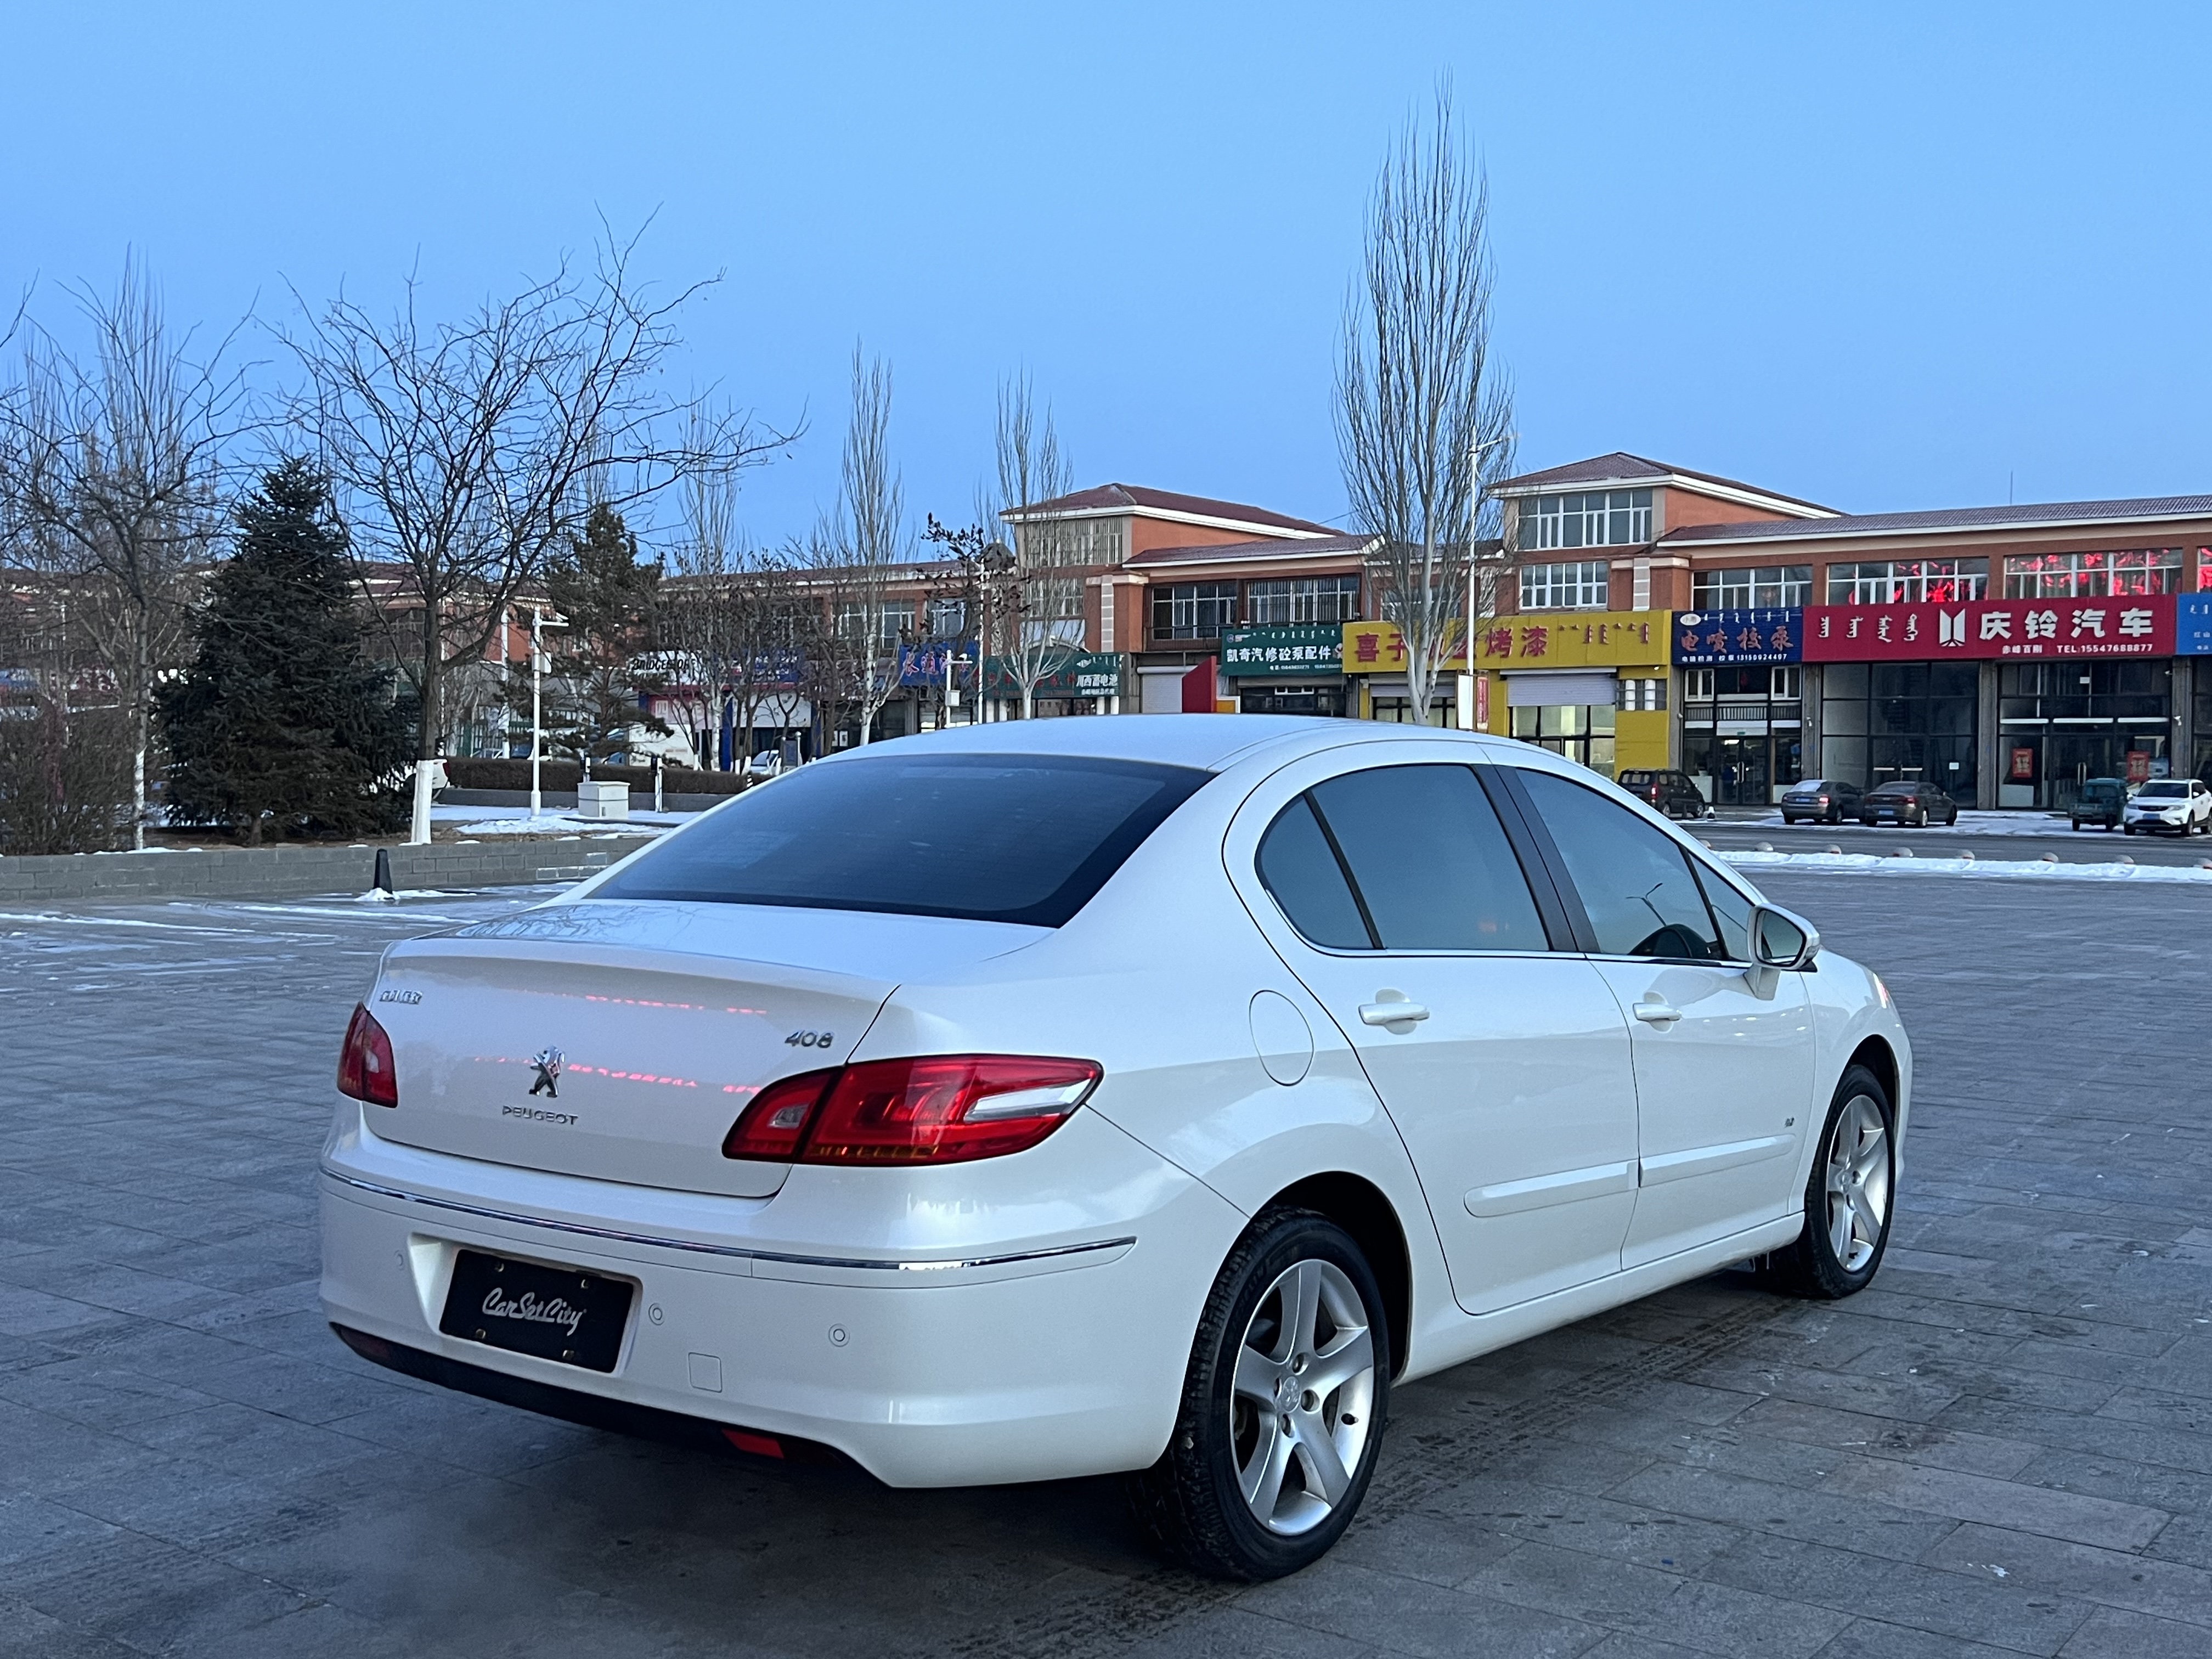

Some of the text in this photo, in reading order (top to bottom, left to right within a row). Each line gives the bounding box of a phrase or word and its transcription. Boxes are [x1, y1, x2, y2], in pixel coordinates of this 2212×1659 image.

[1979, 608, 2153, 640] 庆铃汽车
[1227, 645, 1331, 662] 凯奇汽修砼泵配件
[1355, 626, 1548, 663] 喜子烤漆
[785, 1030, 833, 1048] 408
[503, 1105, 578, 1125] PEUGEOT
